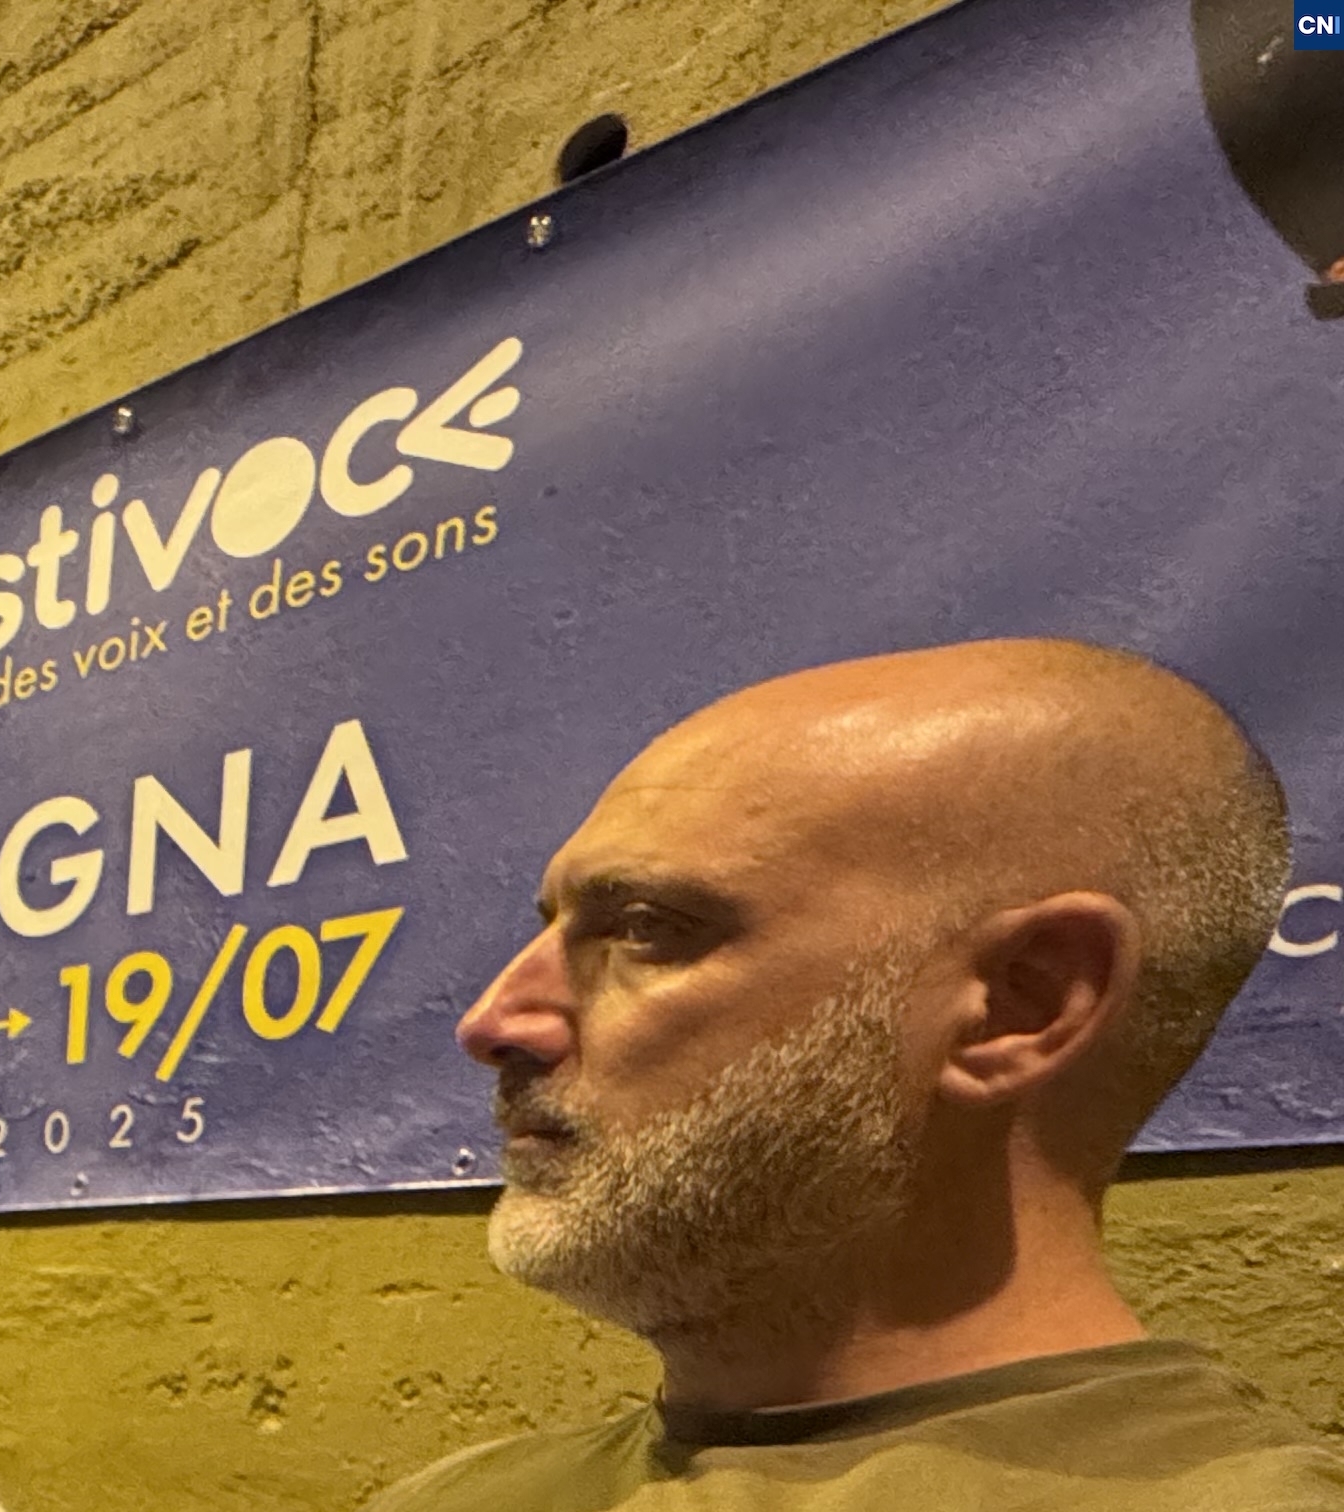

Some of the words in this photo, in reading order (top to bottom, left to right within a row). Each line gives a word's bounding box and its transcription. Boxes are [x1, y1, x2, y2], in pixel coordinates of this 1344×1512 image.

[72, 615, 168, 679] voix
[184, 587, 233, 643] et
[248, 558, 343, 621] des
[364, 503, 499, 583] sons
[58, 906, 406, 1083] 19/07
